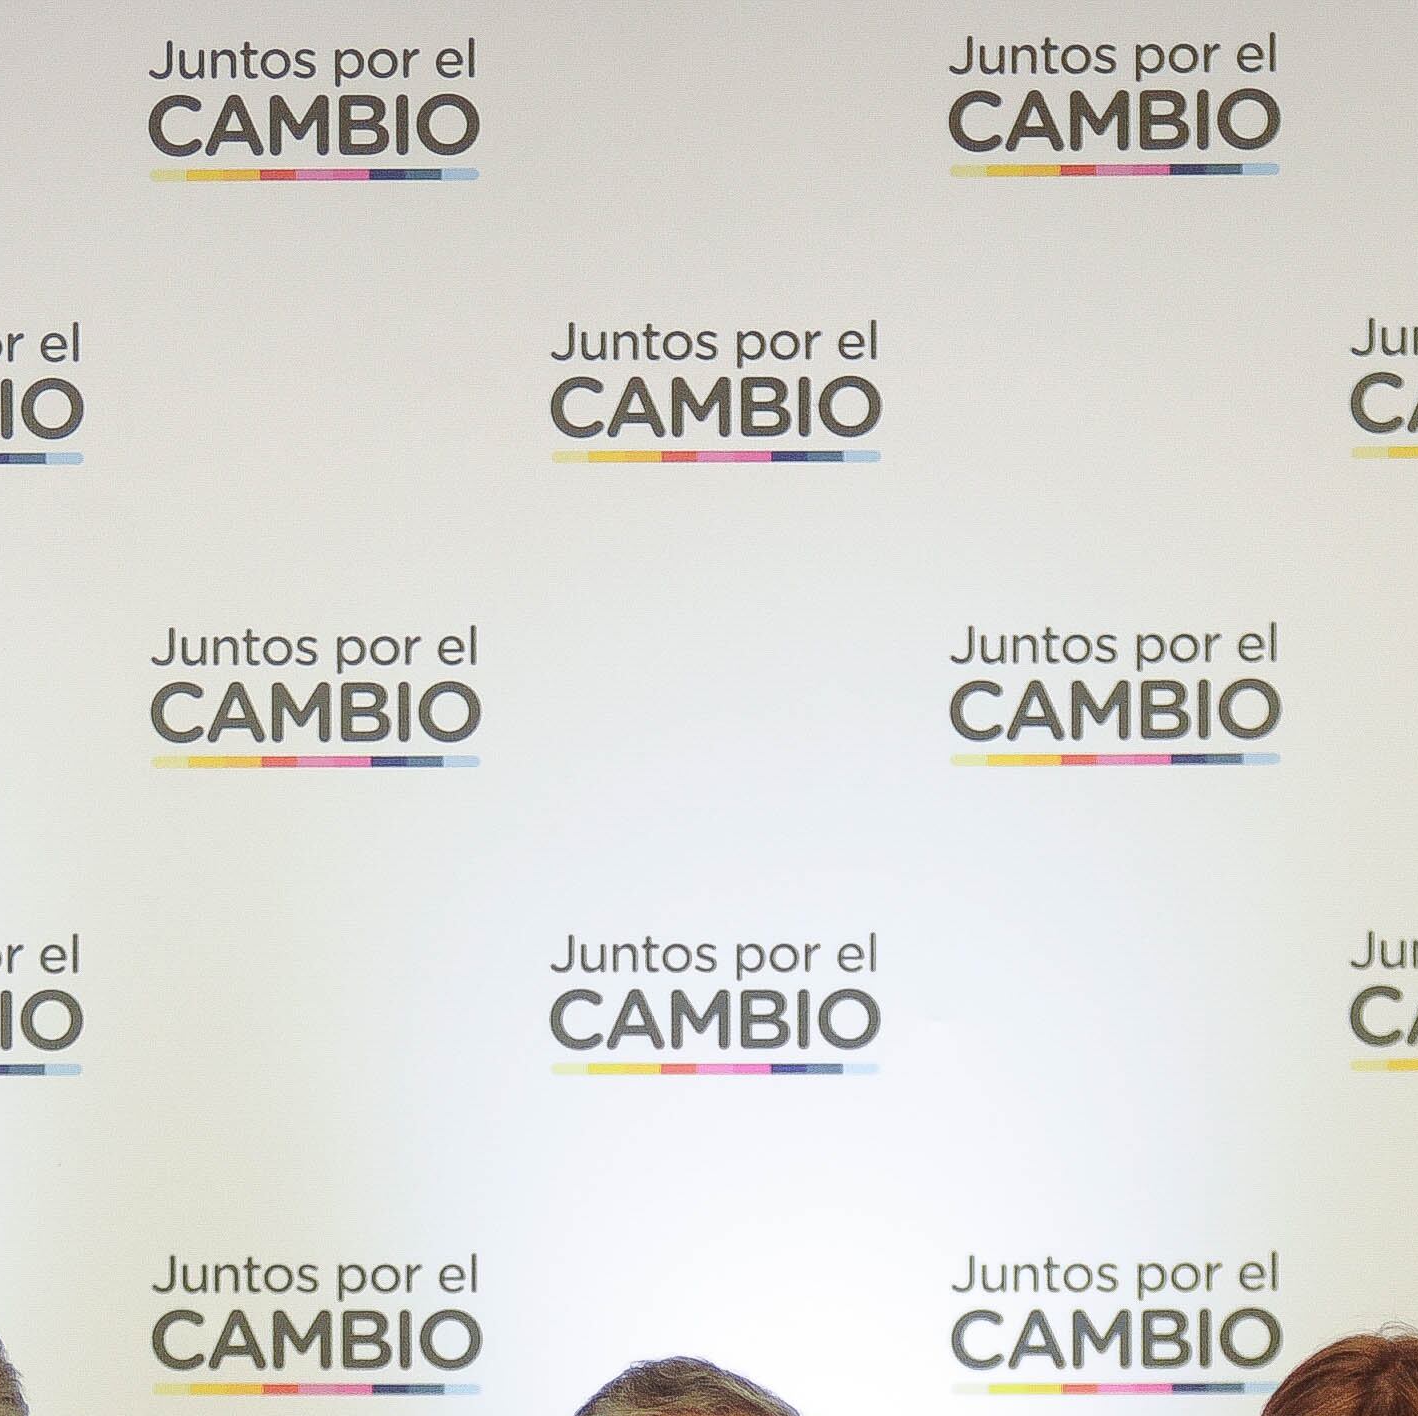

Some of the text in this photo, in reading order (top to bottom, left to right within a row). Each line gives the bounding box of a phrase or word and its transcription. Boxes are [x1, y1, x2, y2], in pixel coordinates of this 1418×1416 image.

[148, 37, 476, 88] Juntos por el
[948, 31, 1276, 83] Juntos por el
[147, 93, 481, 158] CAMBIO
[948, 87, 1281, 153] CAMBIO
[40, 321, 80, 363] el
[550, 319, 877, 369] Juntos por el
[550, 375, 882, 439] CAMBIO
[151, 625, 477, 675] Juntos por el
[950, 622, 1277, 671] Juntos por el
[150, 680, 482, 744] CAMBIO
[949, 677, 1281, 742] CAMBIO
[39, 933, 79, 974] el
[550, 932, 876, 981] Juntos por el
[549, 988, 881, 1051] CAMBIO
[152, 1253, 477, 1302] Juntos por el
[952, 1252, 1277, 1300] Juntos por el
[151, 1308, 483, 1371] CAMBIO
[950, 1307, 1282, 1370] CAMBIO
